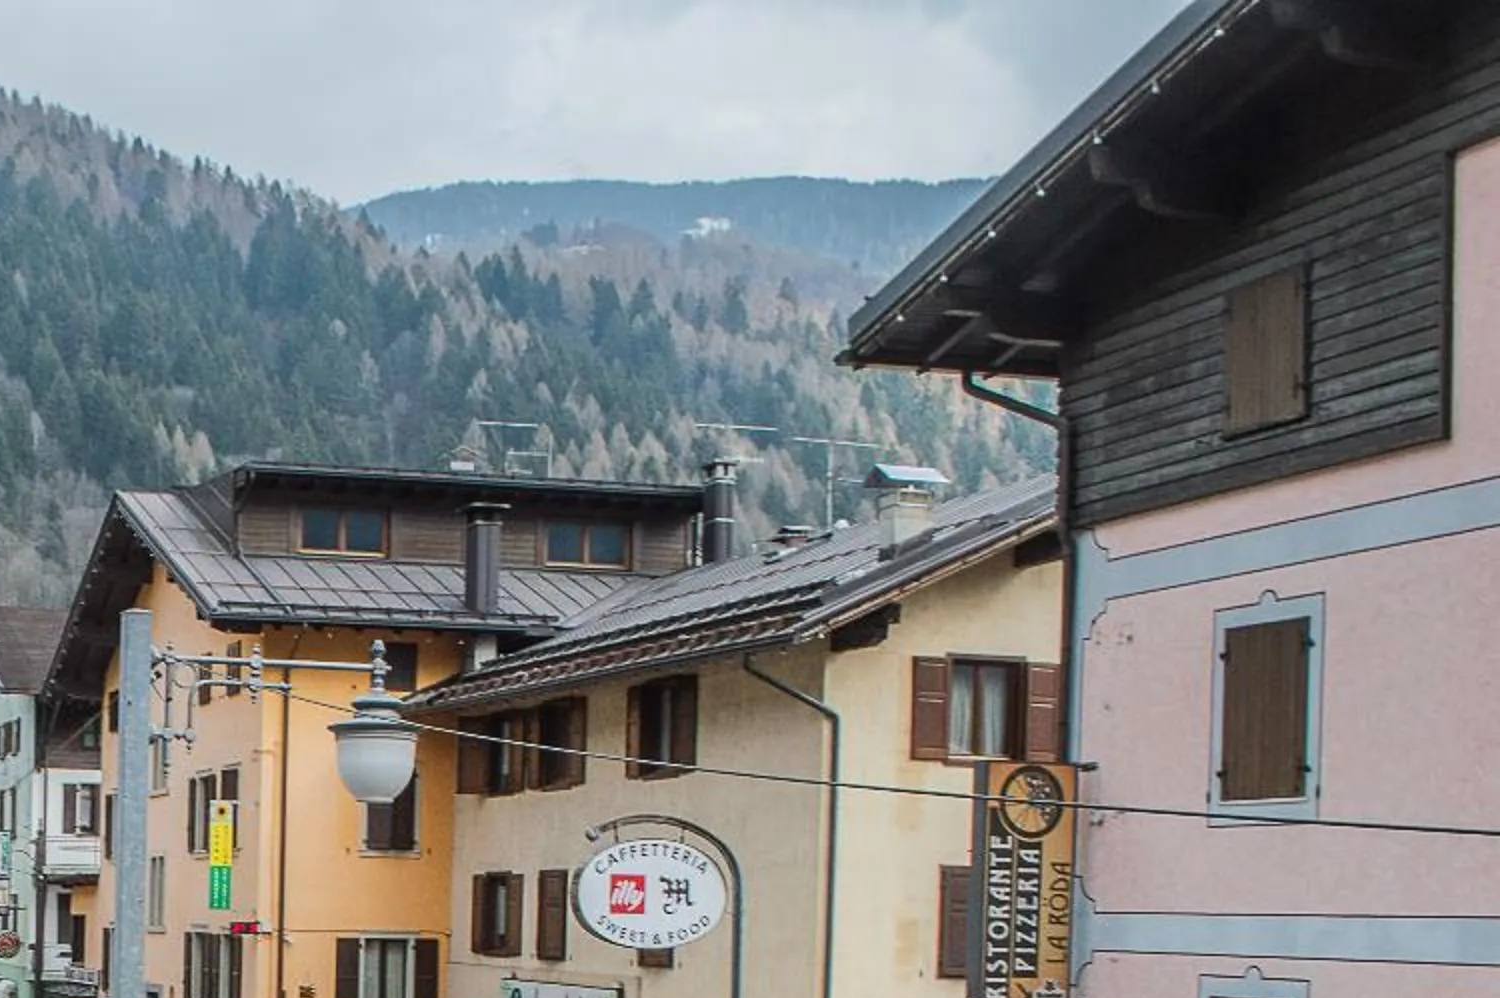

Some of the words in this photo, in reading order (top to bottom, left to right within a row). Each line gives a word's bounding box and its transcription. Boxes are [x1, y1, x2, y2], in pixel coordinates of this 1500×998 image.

[595, 843, 708, 875] CAFFETTERIA
[611, 880, 645, 912] illy
[1014, 847, 1041, 972] PIZZERIA
[597, 915, 646, 943] SWEET
[668, 915, 711, 943] FOOD
[1046, 935, 1069, 963] LA
